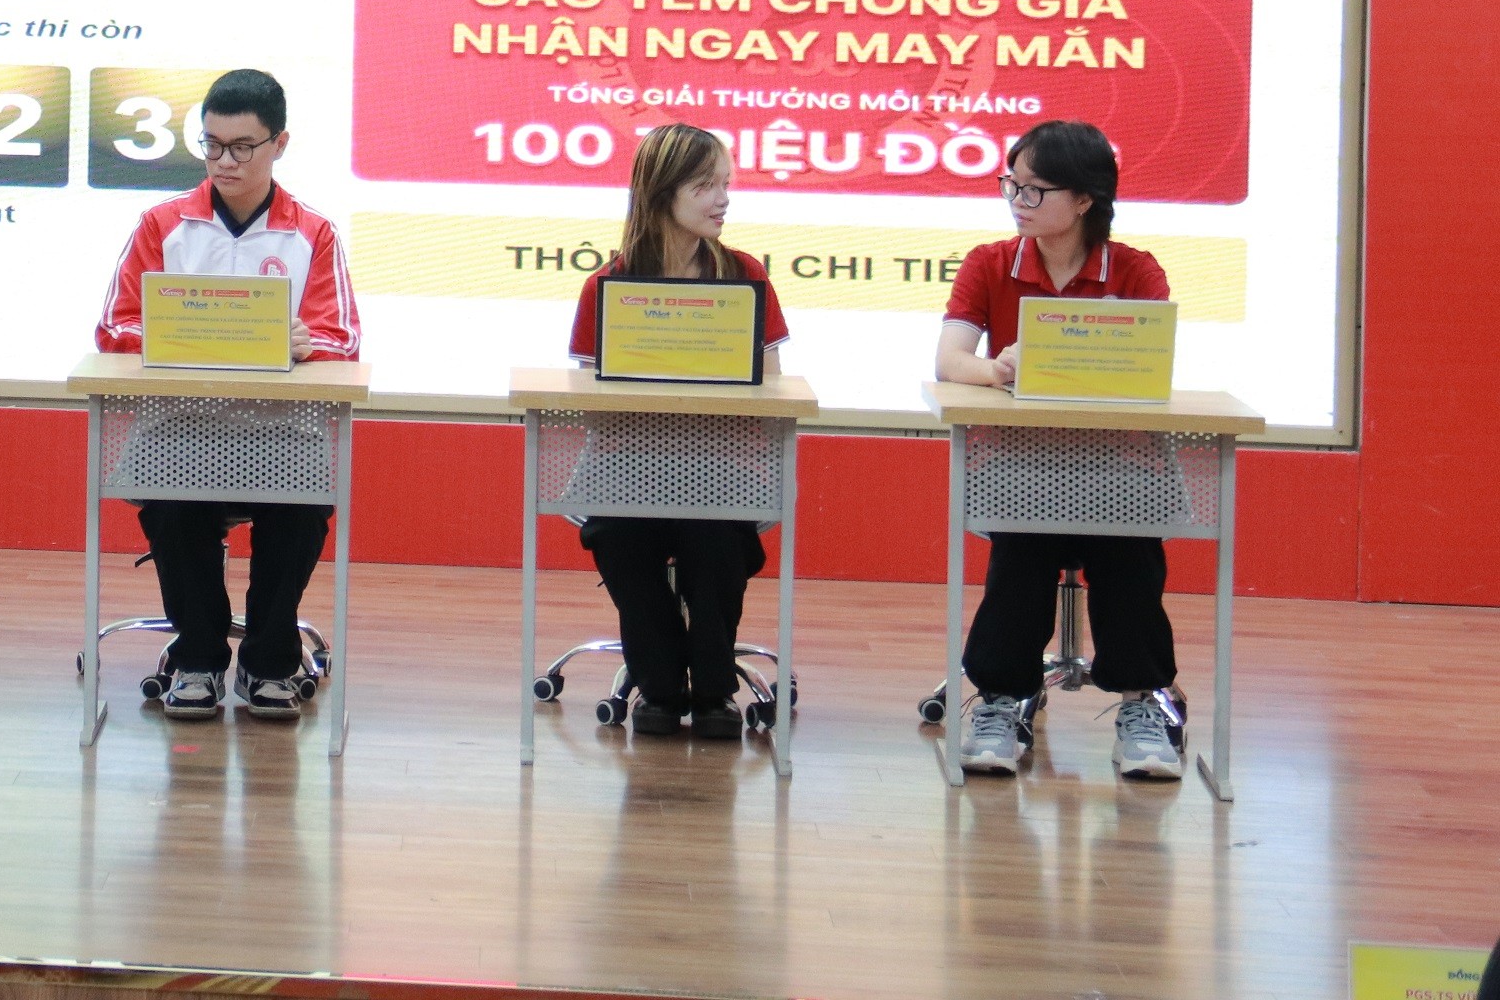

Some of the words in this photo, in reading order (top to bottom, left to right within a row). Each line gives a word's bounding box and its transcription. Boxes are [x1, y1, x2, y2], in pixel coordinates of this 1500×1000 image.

[25, 19, 69, 38] thi
[80, 18, 143, 40] còn
[452, 15, 629, 64] NHẬN
[645, 27, 820, 63] NGAY
[835, 32, 982, 65] MAY
[995, 25, 1146, 69] MẮN
[642, 83, 705, 106] GIẢI
[711, 85, 852, 110] THƯỞNG
[927, 92, 1042, 115] THÁNG
[473, 122, 615, 166] 100
[790, 254, 874, 281] CHI
[894, 251, 960, 283] TIẾ
